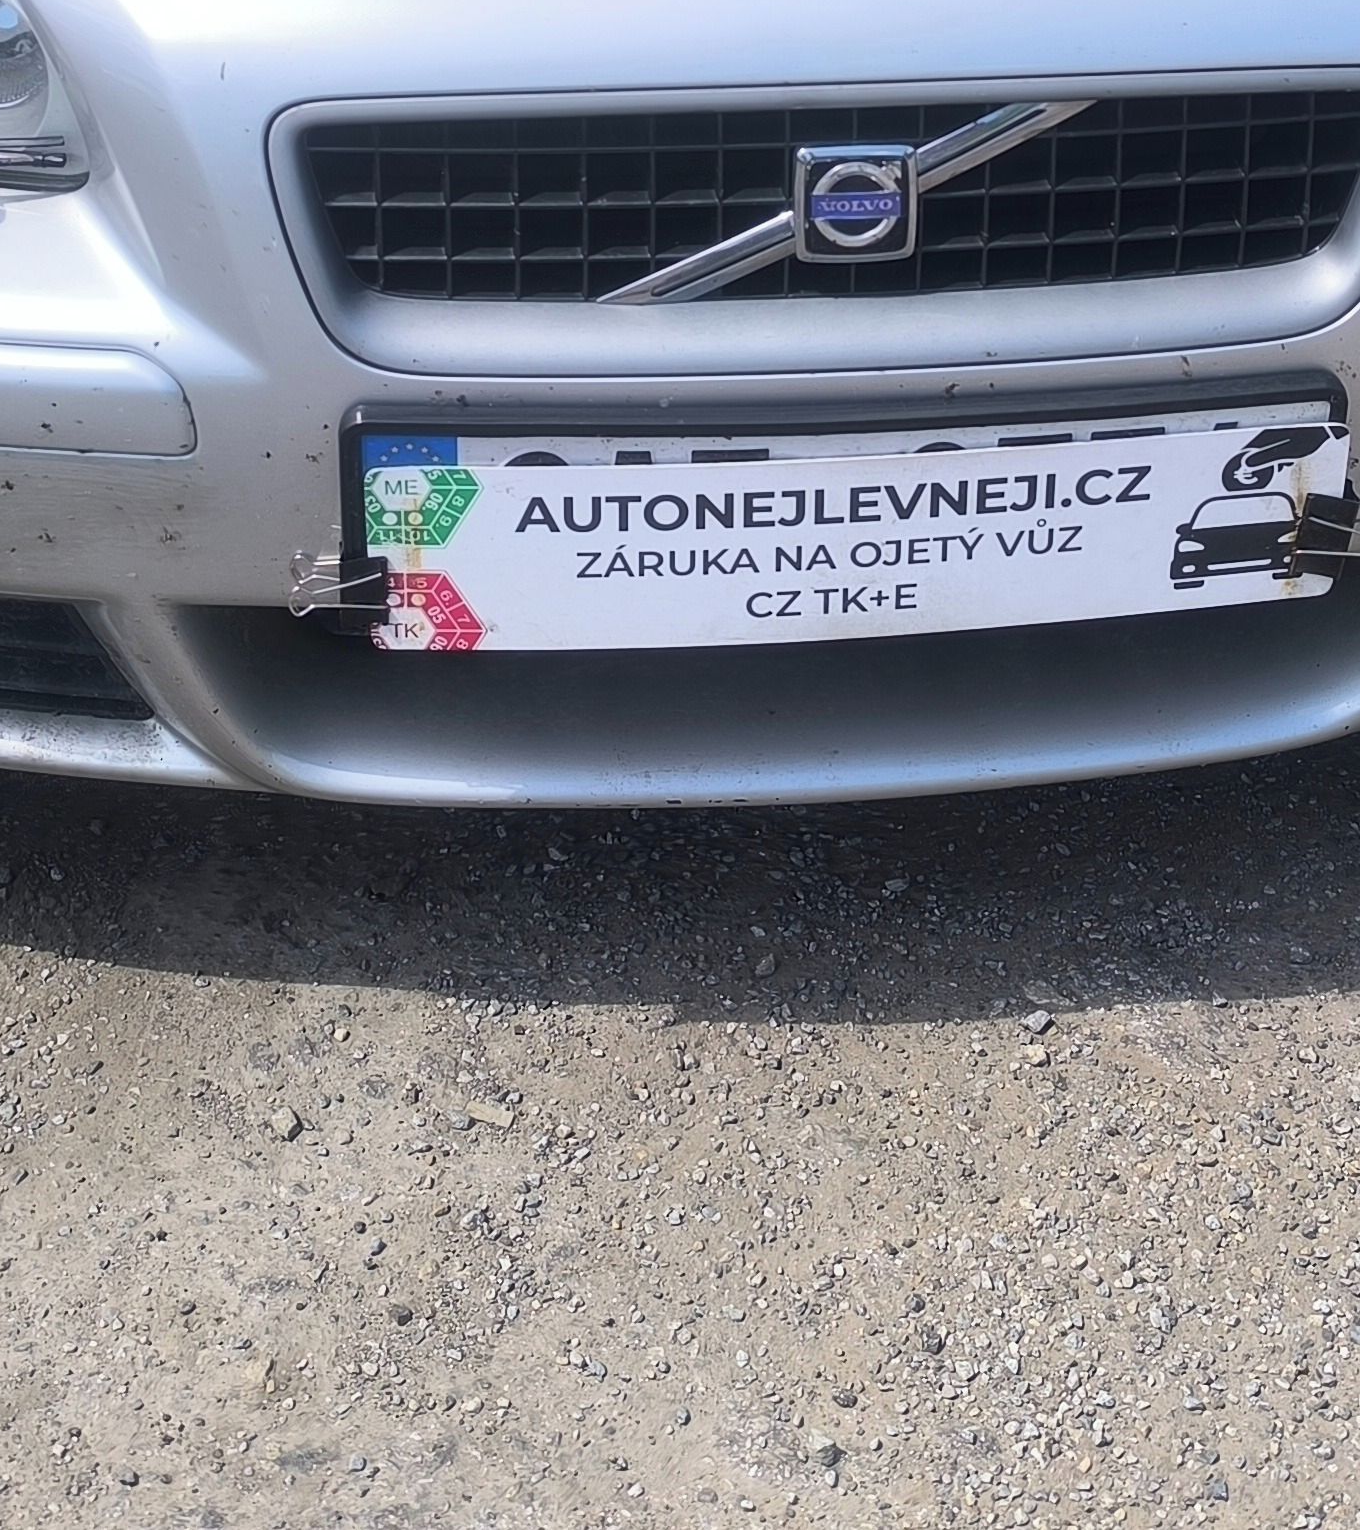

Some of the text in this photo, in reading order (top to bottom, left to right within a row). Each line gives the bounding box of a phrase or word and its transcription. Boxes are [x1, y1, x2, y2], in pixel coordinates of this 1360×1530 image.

[820, 198, 893, 212] VOLVO
[384, 480, 419, 496] ME
[514, 465, 1152, 533] AUTONEJLEVNEJI.CZ
[576, 518, 1083, 579] ZÁRUKA NA OJETÝ VŮZ
[746, 583, 918, 618] CZ TK+E
[391, 623, 420, 639] TK
